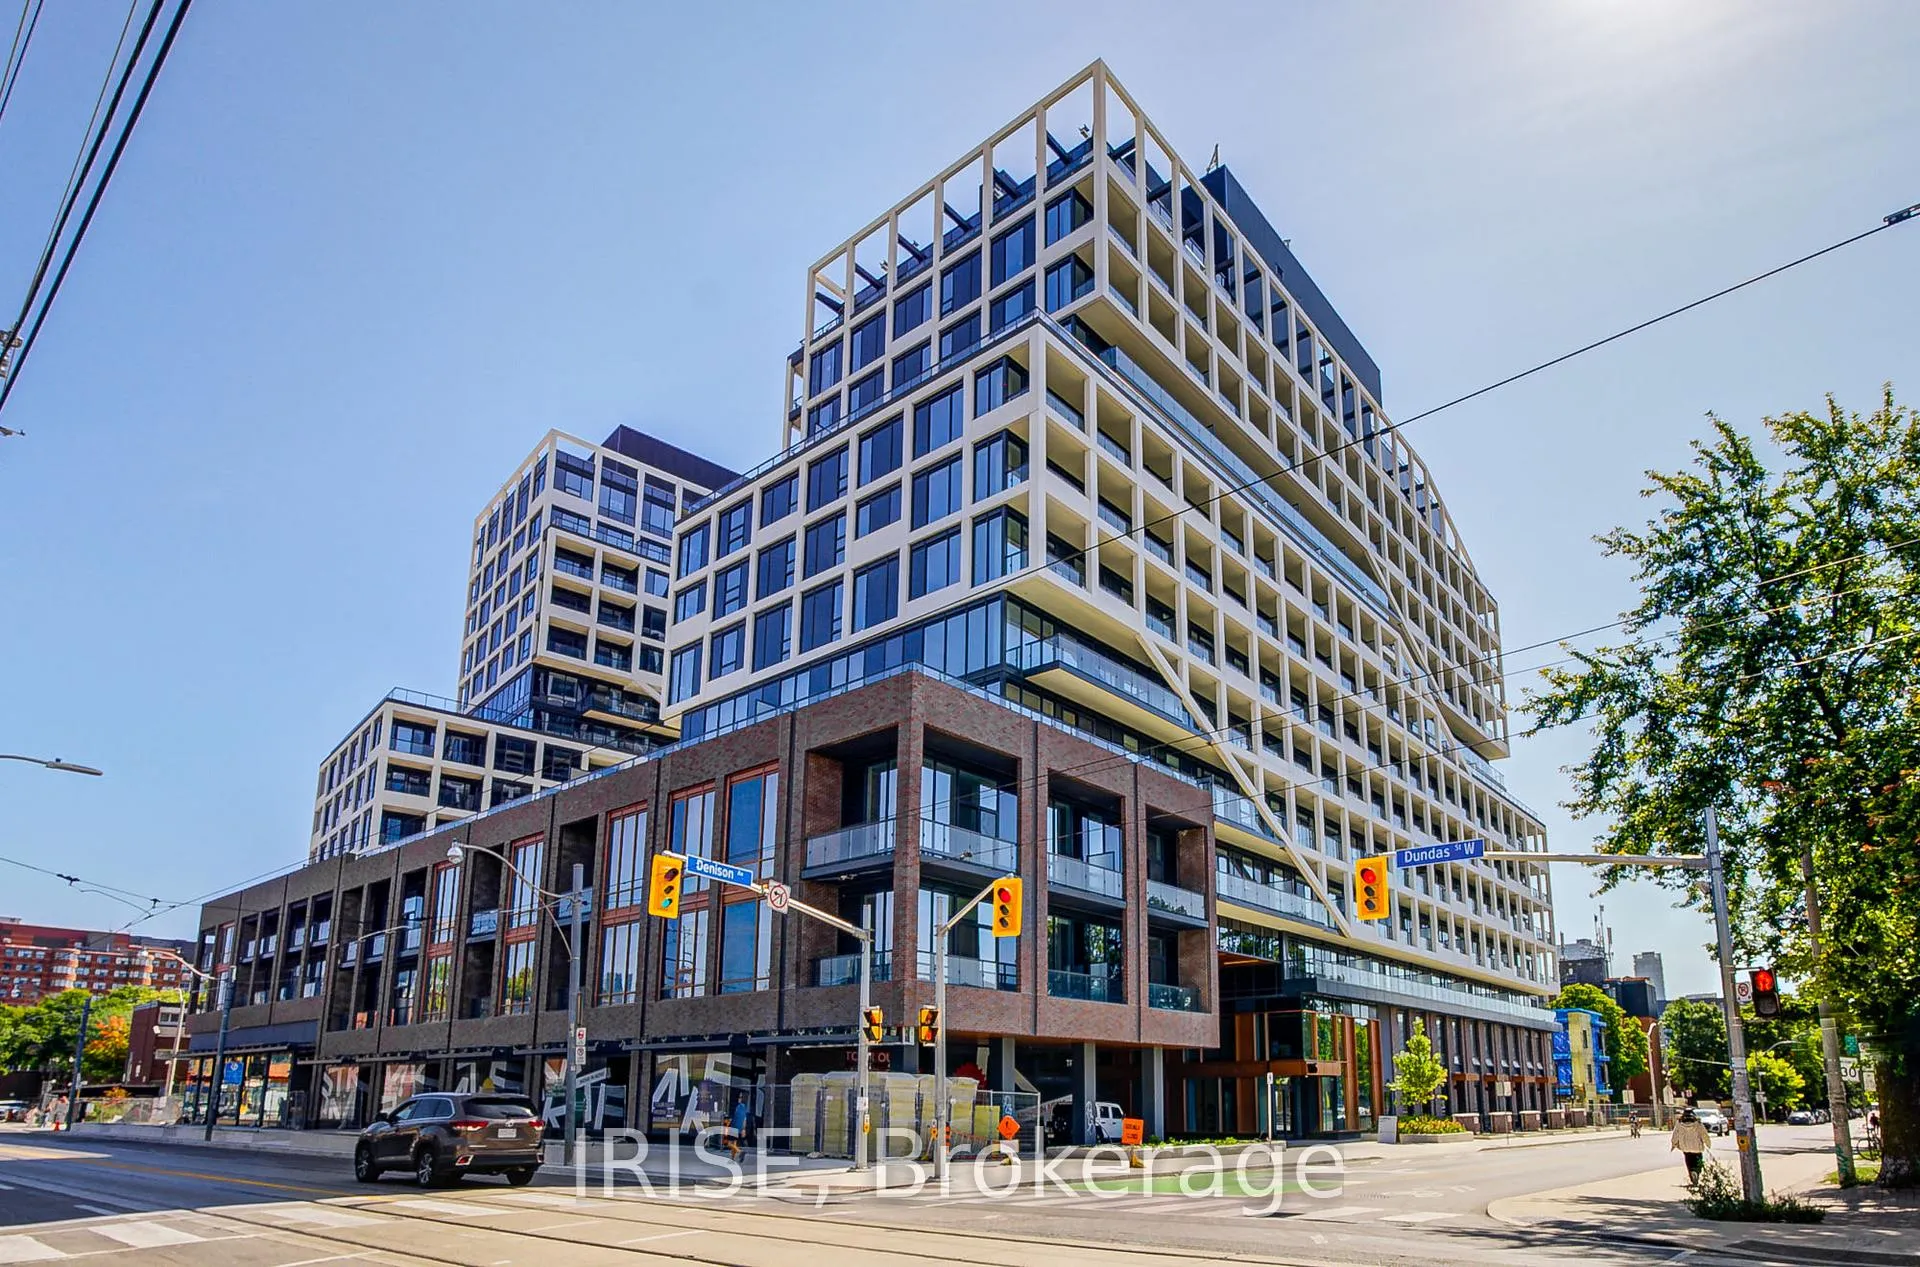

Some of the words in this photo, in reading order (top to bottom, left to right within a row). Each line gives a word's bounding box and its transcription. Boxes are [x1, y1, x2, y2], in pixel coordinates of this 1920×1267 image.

[1404, 847, 1450, 862] Dundas
[1463, 841, 1475, 855] W
[696, 860, 734, 879] Denison
[1840, 1066, 1857, 1077] 30
